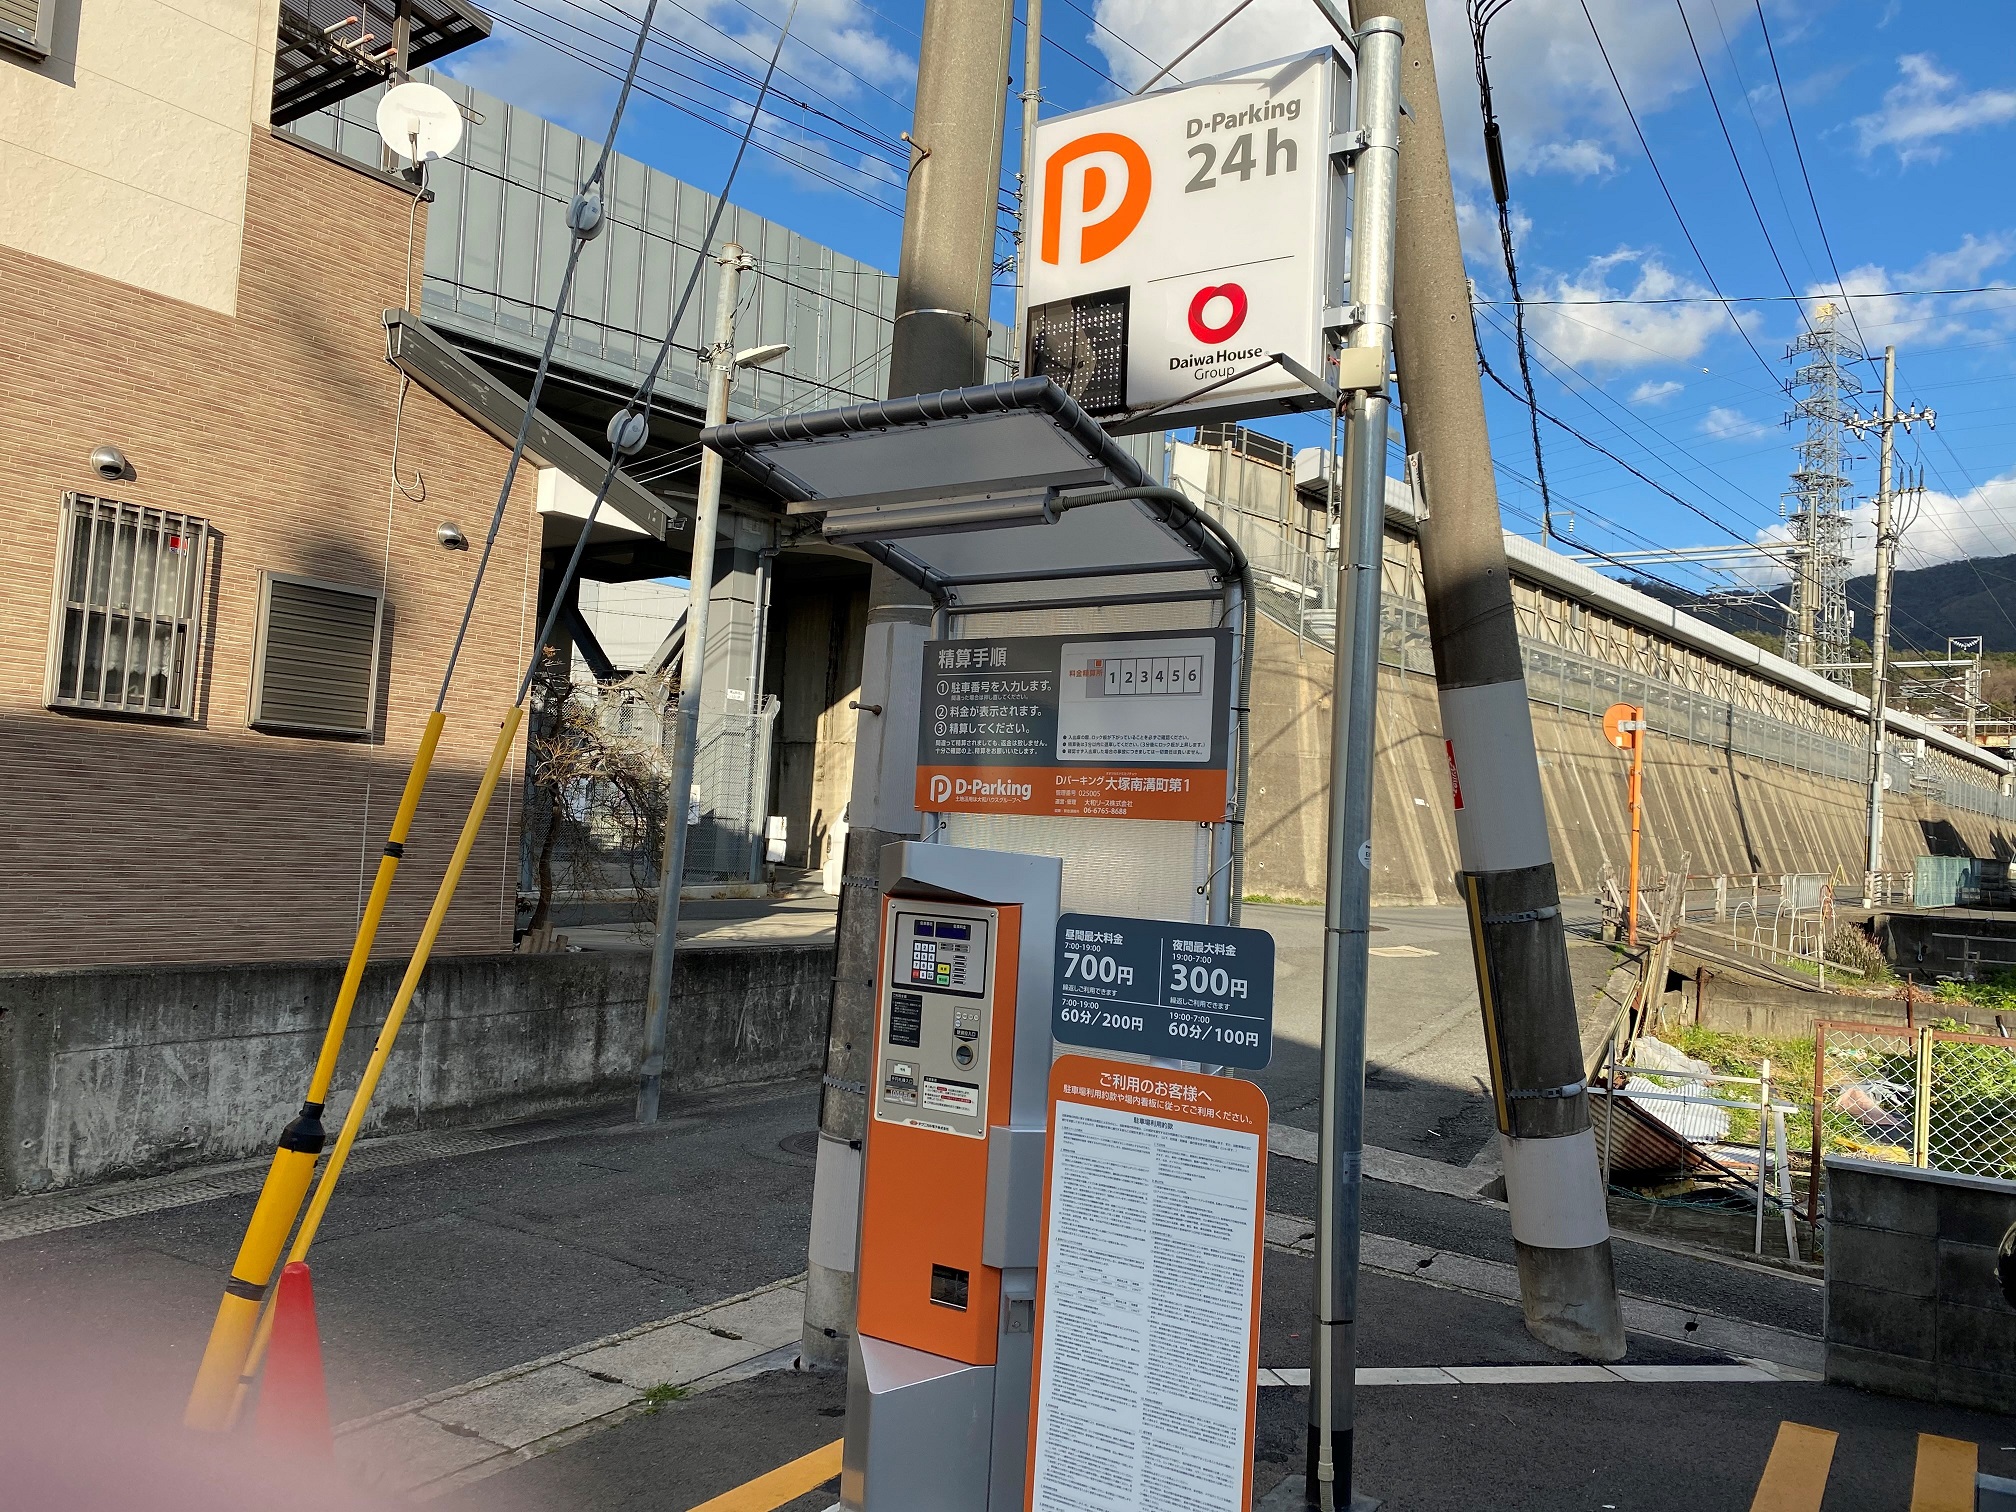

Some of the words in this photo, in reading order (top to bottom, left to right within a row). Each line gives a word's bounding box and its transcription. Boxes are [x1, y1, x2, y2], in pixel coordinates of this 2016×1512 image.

[1186, 98, 1301, 140] D-Parking
[1169, 353, 1214, 370] Daiwa
[1217, 347, 1263, 364] House
[1194, 365, 1235, 381] Group
[938, 647, 1007, 669] 精算手順
[1110, 672, 1114, 684] 1
[1125, 672, 1132, 683] 2
[1140, 671, 1148, 682] 3
[1156, 670, 1164, 682] 4
[1172, 670, 1180, 682] 5
[1188, 670, 1196, 682] 6
[956, 778, 1032, 800] D-Parking
[1065, 928, 1124, 946] 昼間最大料金
[1064, 942, 1102, 952] 7:00-19:00
[1172, 939, 1237, 957] 夜間最大料金
[1172, 954, 1212, 964] 19:00-7:00
[1063, 952, 1134, 986] 700円
[1170, 964, 1248, 1000] 300円
[1062, 998, 1100, 1010] 7:00-19:00
[1169, 1012, 1210, 1024] 19:00-7:00
[1099, 1072, 1212, 1102] ご利用のお客様へ
